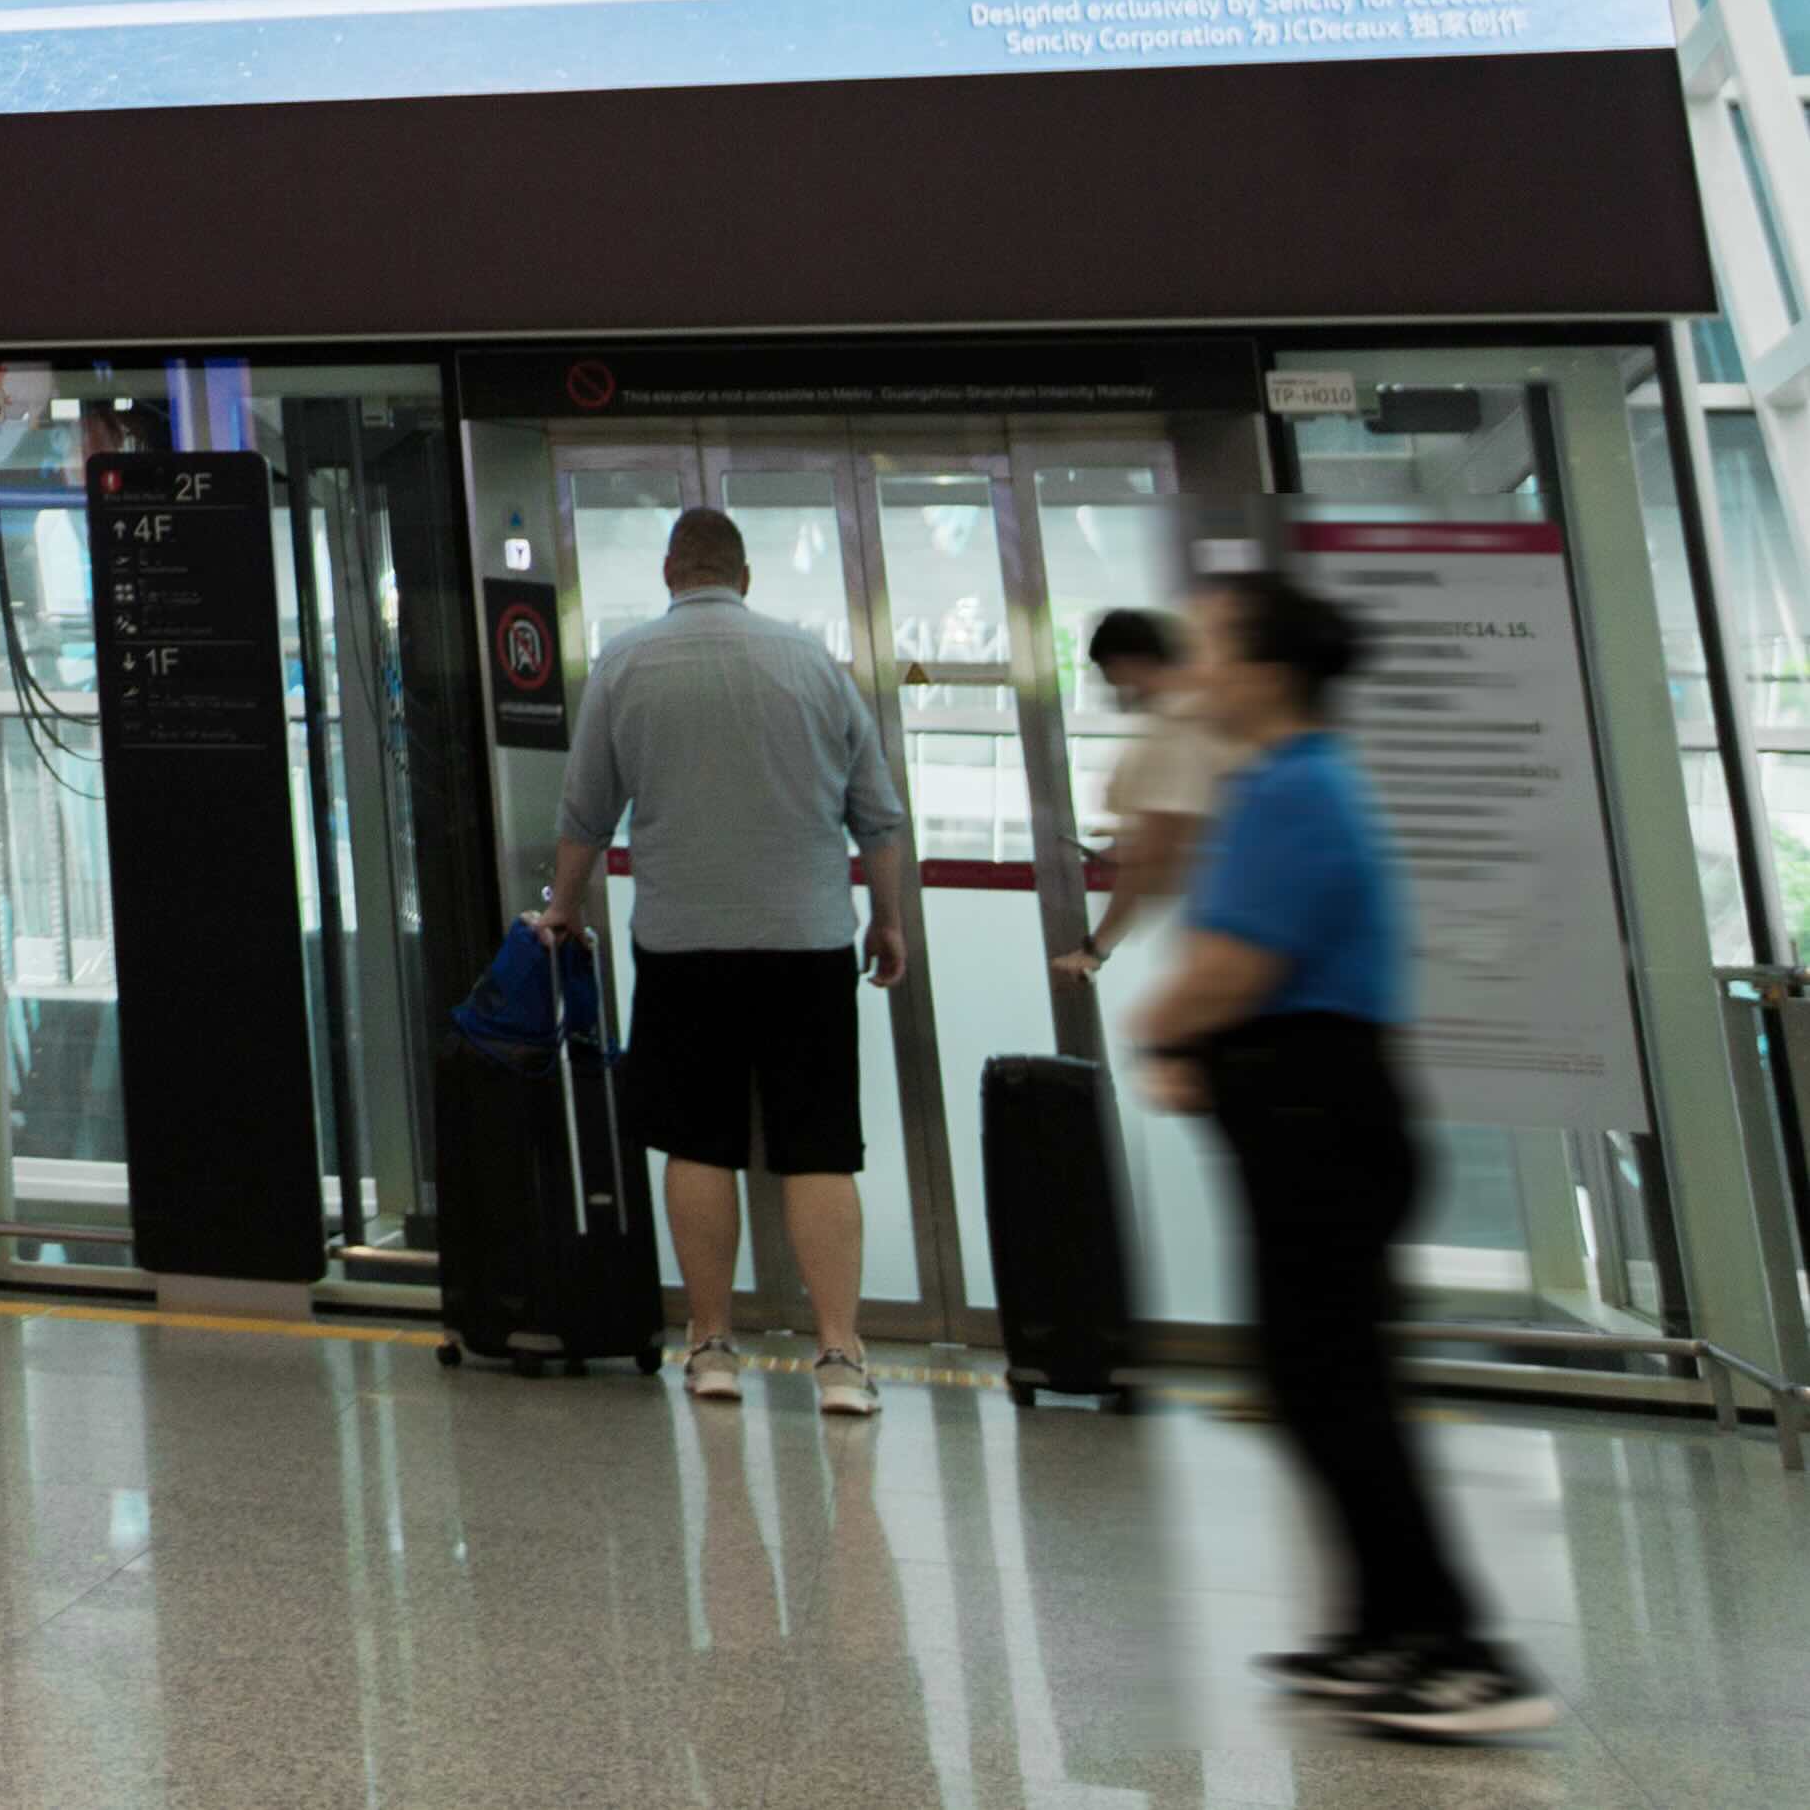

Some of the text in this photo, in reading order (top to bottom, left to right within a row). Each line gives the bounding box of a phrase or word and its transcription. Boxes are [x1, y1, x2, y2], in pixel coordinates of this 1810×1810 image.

[1006, 28, 1093, 56] Sencity
[1099, 22, 1245, 53] Corporation
[1283, 16, 1403, 43] JCDecaux
[174, 472, 212, 501] 2F
[133, 513, 173, 542] 4F
[145, 646, 179, 676] 1F
